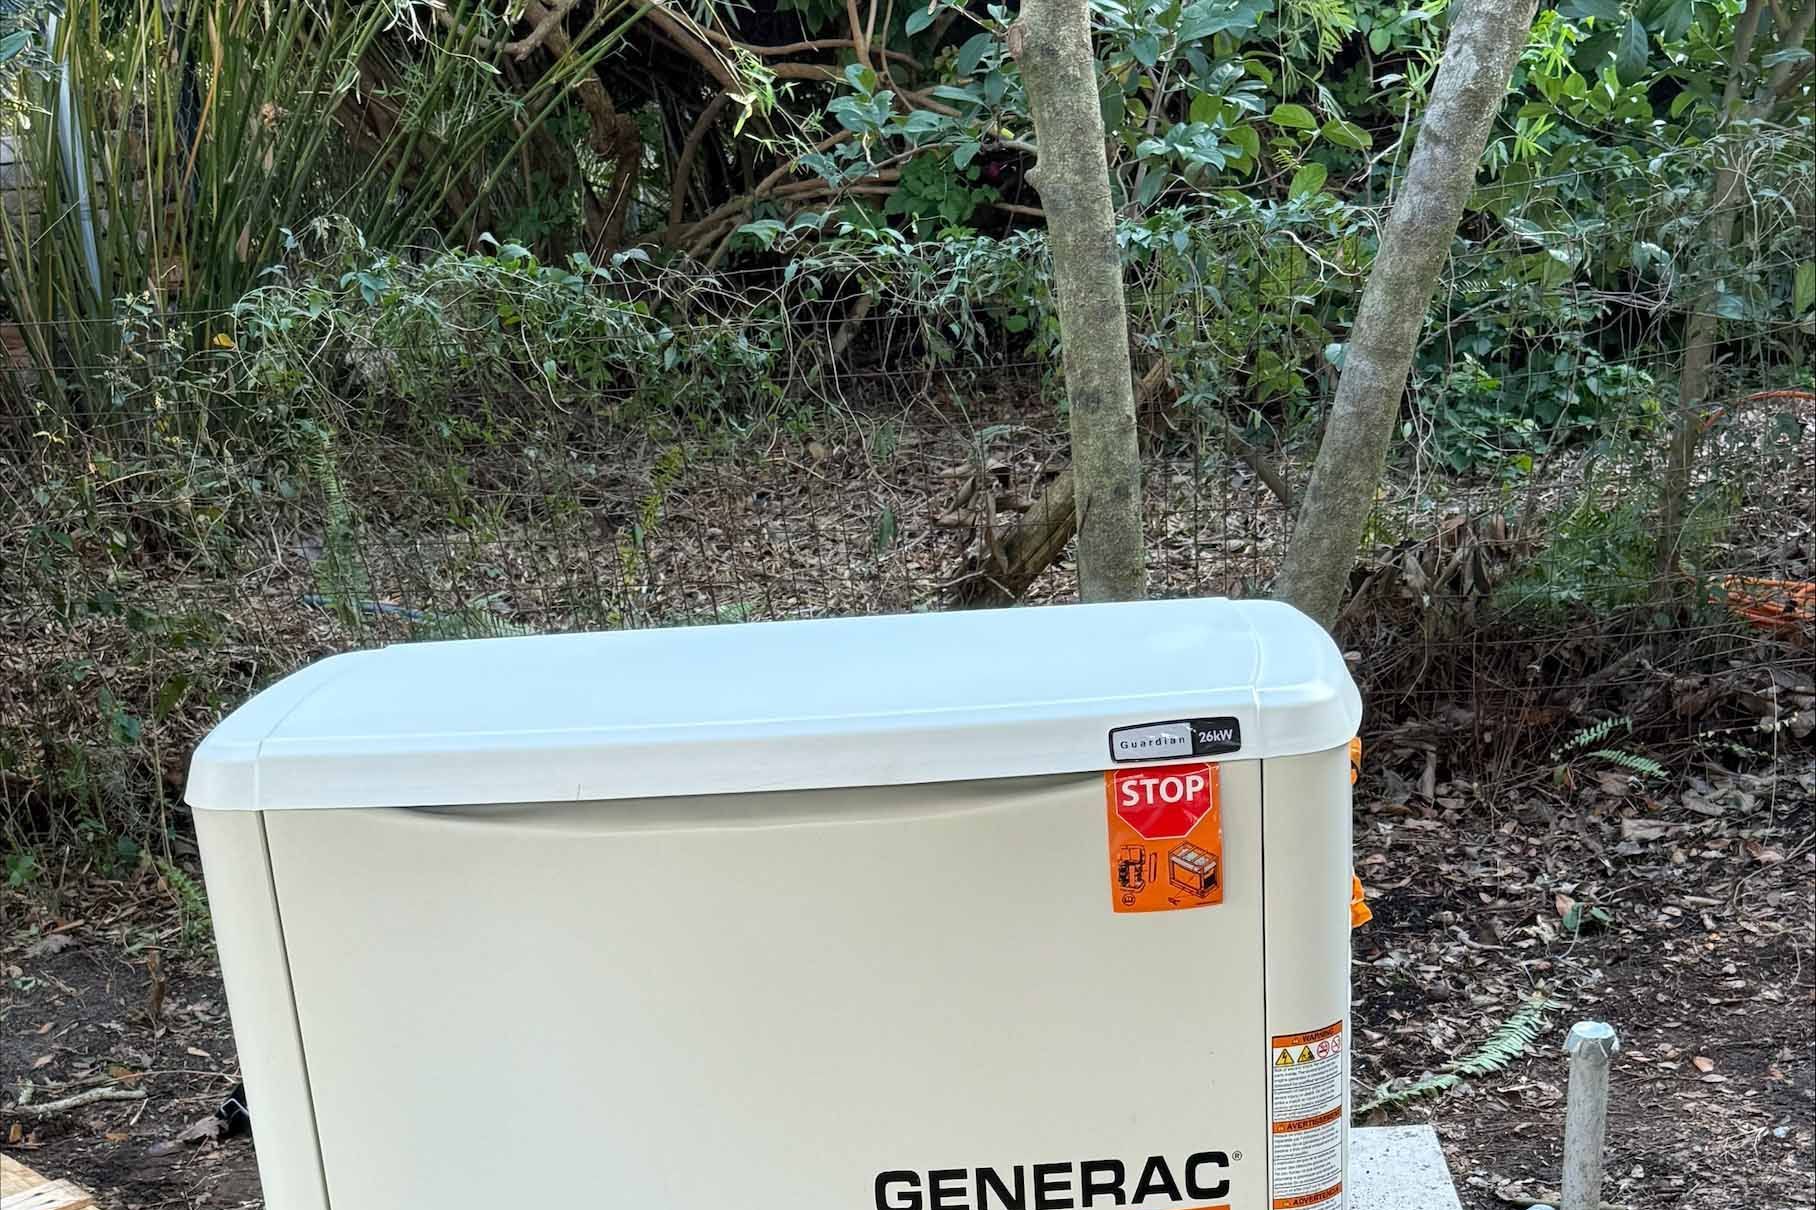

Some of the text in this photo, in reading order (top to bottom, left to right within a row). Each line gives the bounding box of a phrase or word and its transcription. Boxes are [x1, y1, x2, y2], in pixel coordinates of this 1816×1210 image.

[1119, 729, 1233, 750] Guardian 26kW
[1121, 774, 1205, 807] STOP
[1286, 1107, 1341, 1131] AVERTIET
